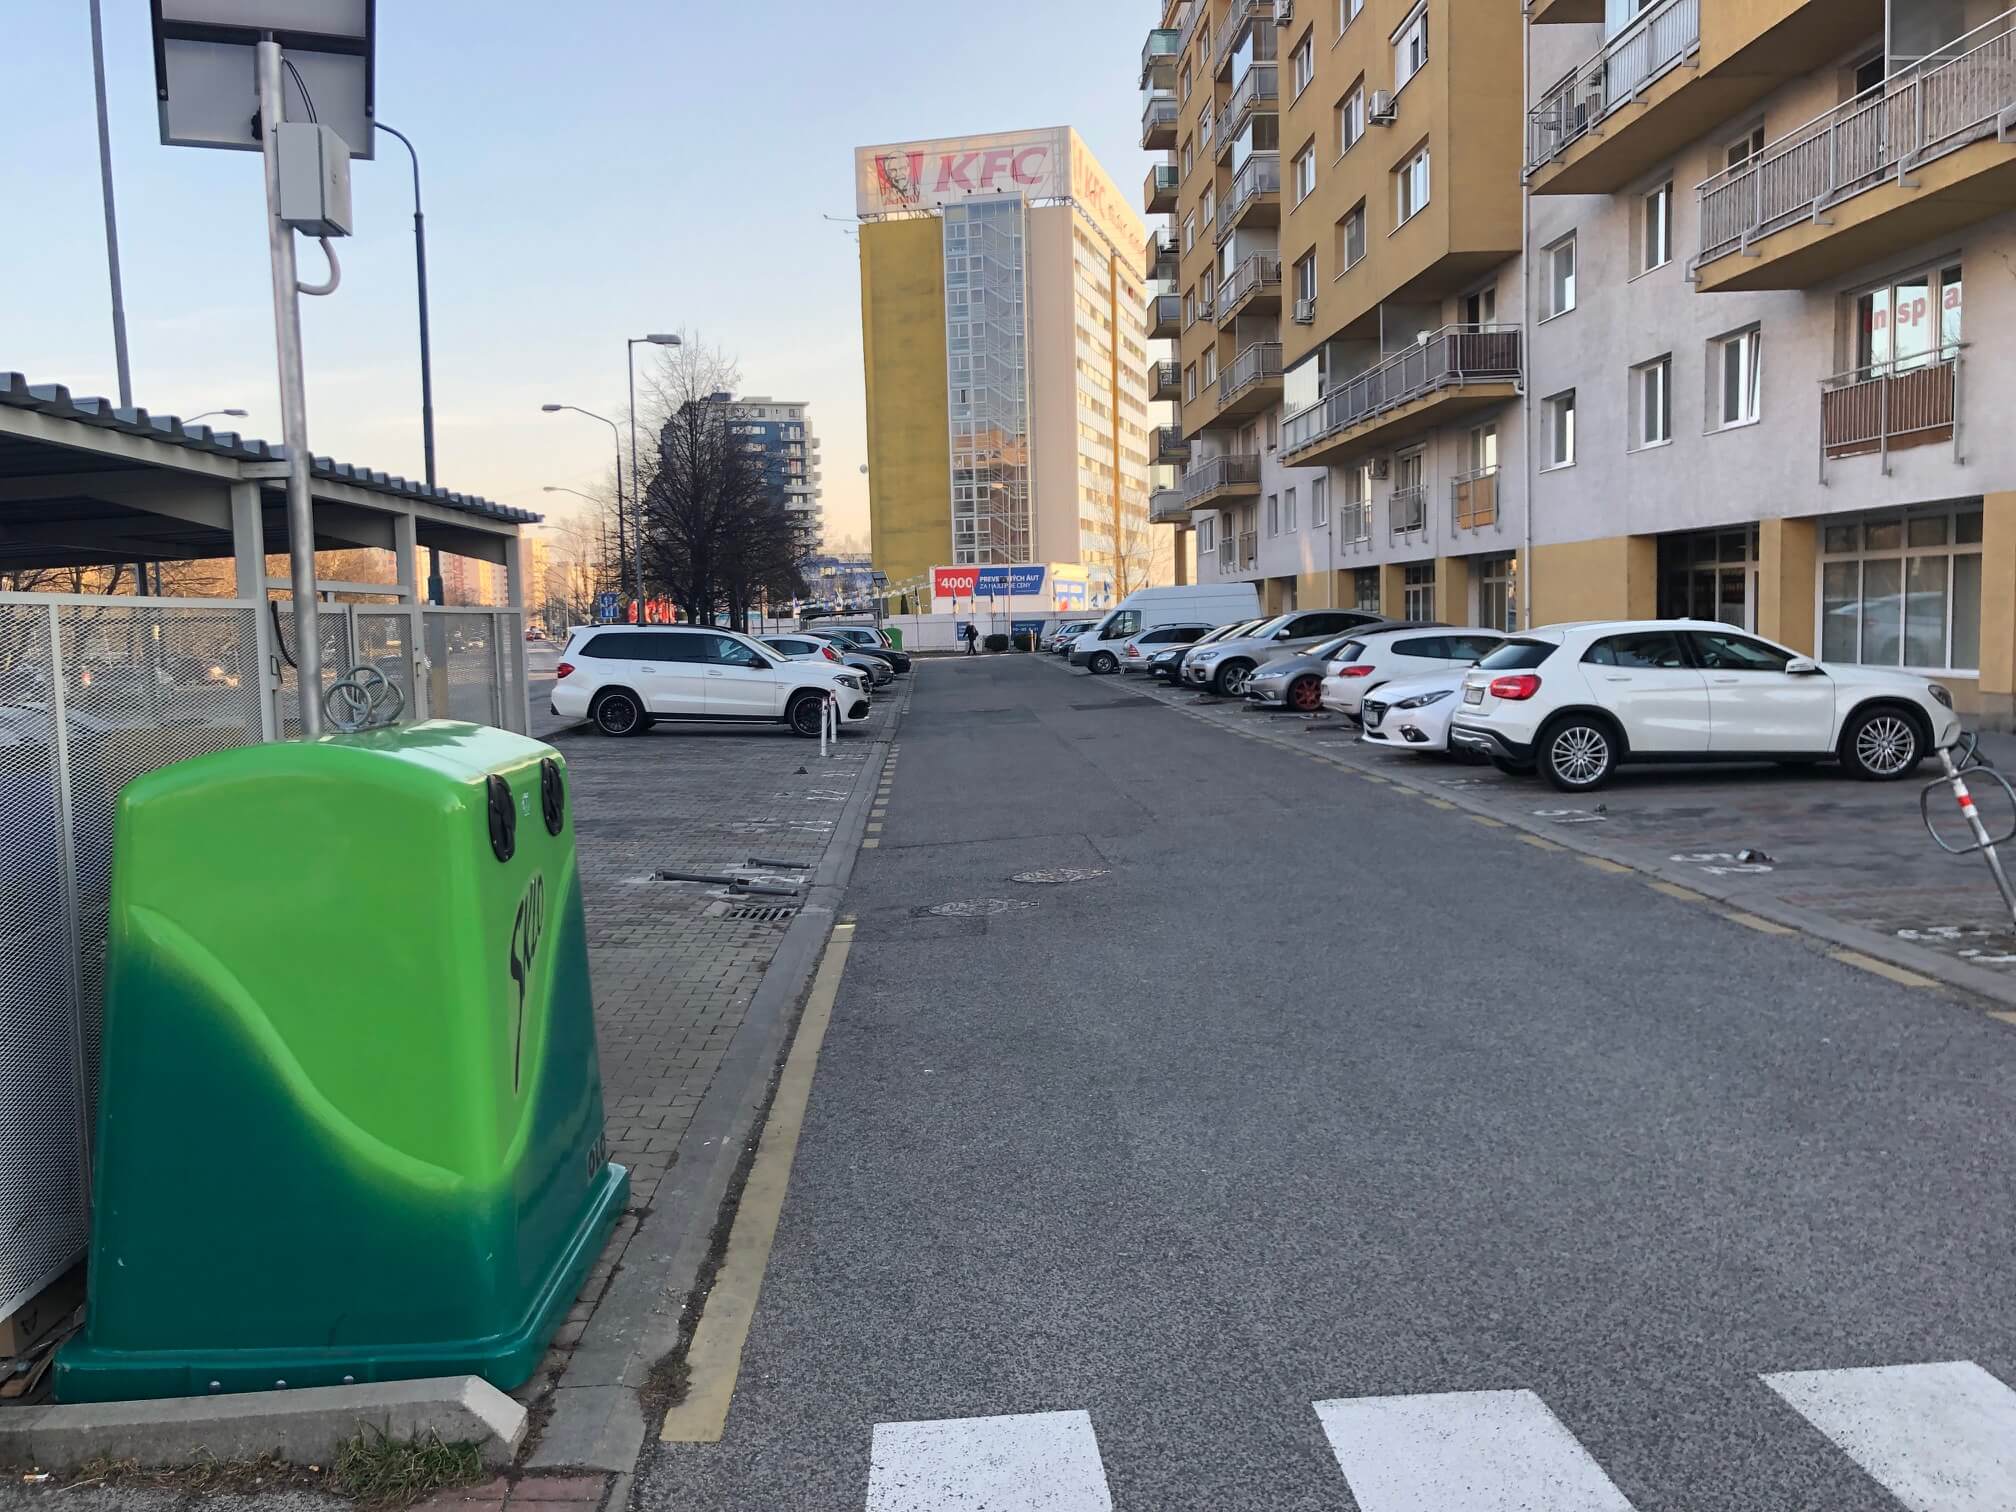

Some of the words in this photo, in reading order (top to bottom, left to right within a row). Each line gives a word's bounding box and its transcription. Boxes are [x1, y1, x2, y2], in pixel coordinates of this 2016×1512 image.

[933, 146, 1049, 193] KFC
[941, 577, 972, 588] 4000
[585, 1130, 606, 1178] OLO
